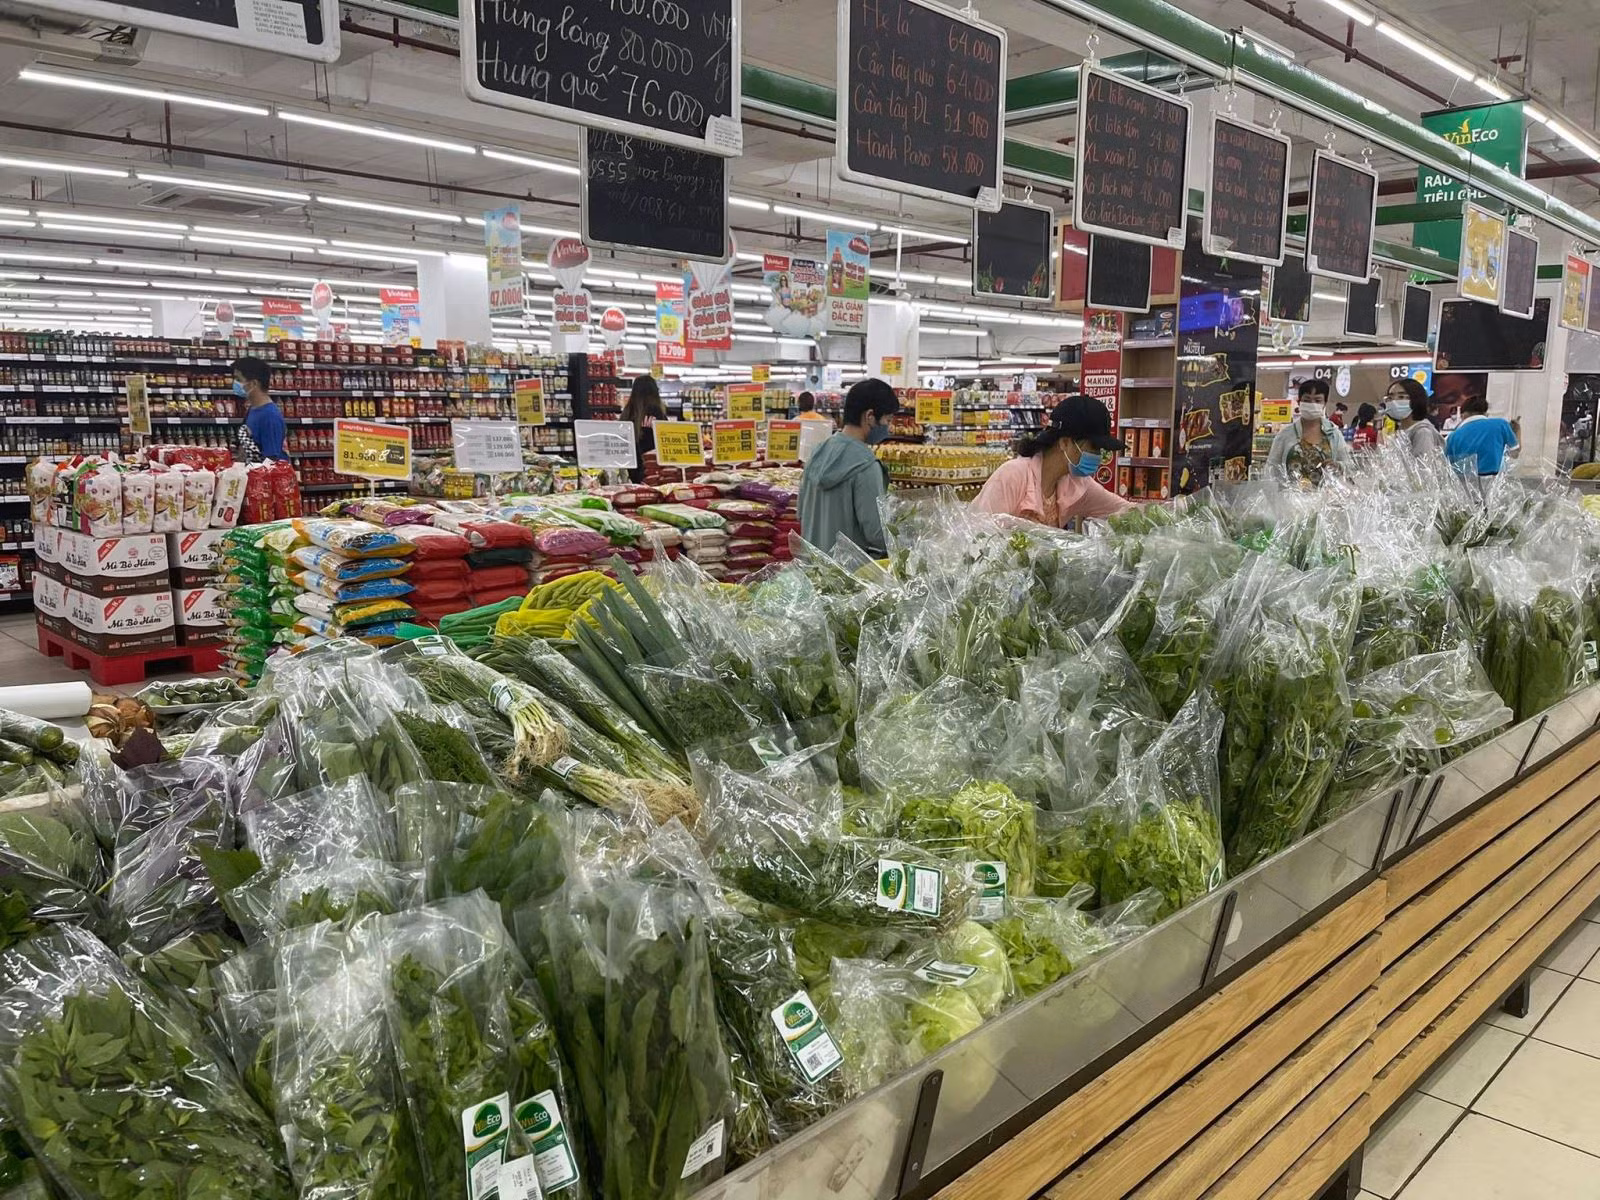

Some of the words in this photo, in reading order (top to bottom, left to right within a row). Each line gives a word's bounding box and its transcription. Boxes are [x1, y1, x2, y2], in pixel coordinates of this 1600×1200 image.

[618, 26, 695, 76] 80.000
[948, 23, 993, 64] 64.000
[946, 63, 994, 104] 64.000
[621, 71, 704, 127] 76.000
[1443, 128, 1499, 146] VinEco
[941, 142, 984, 177] 58.000
[1424, 174, 1453, 188] RAU
[1087, 377, 1115, 385] MAKING
[1315, 367, 1332, 380] 04
[1390, 366, 1410, 378] 03
[944, 378, 955, 387] 09
